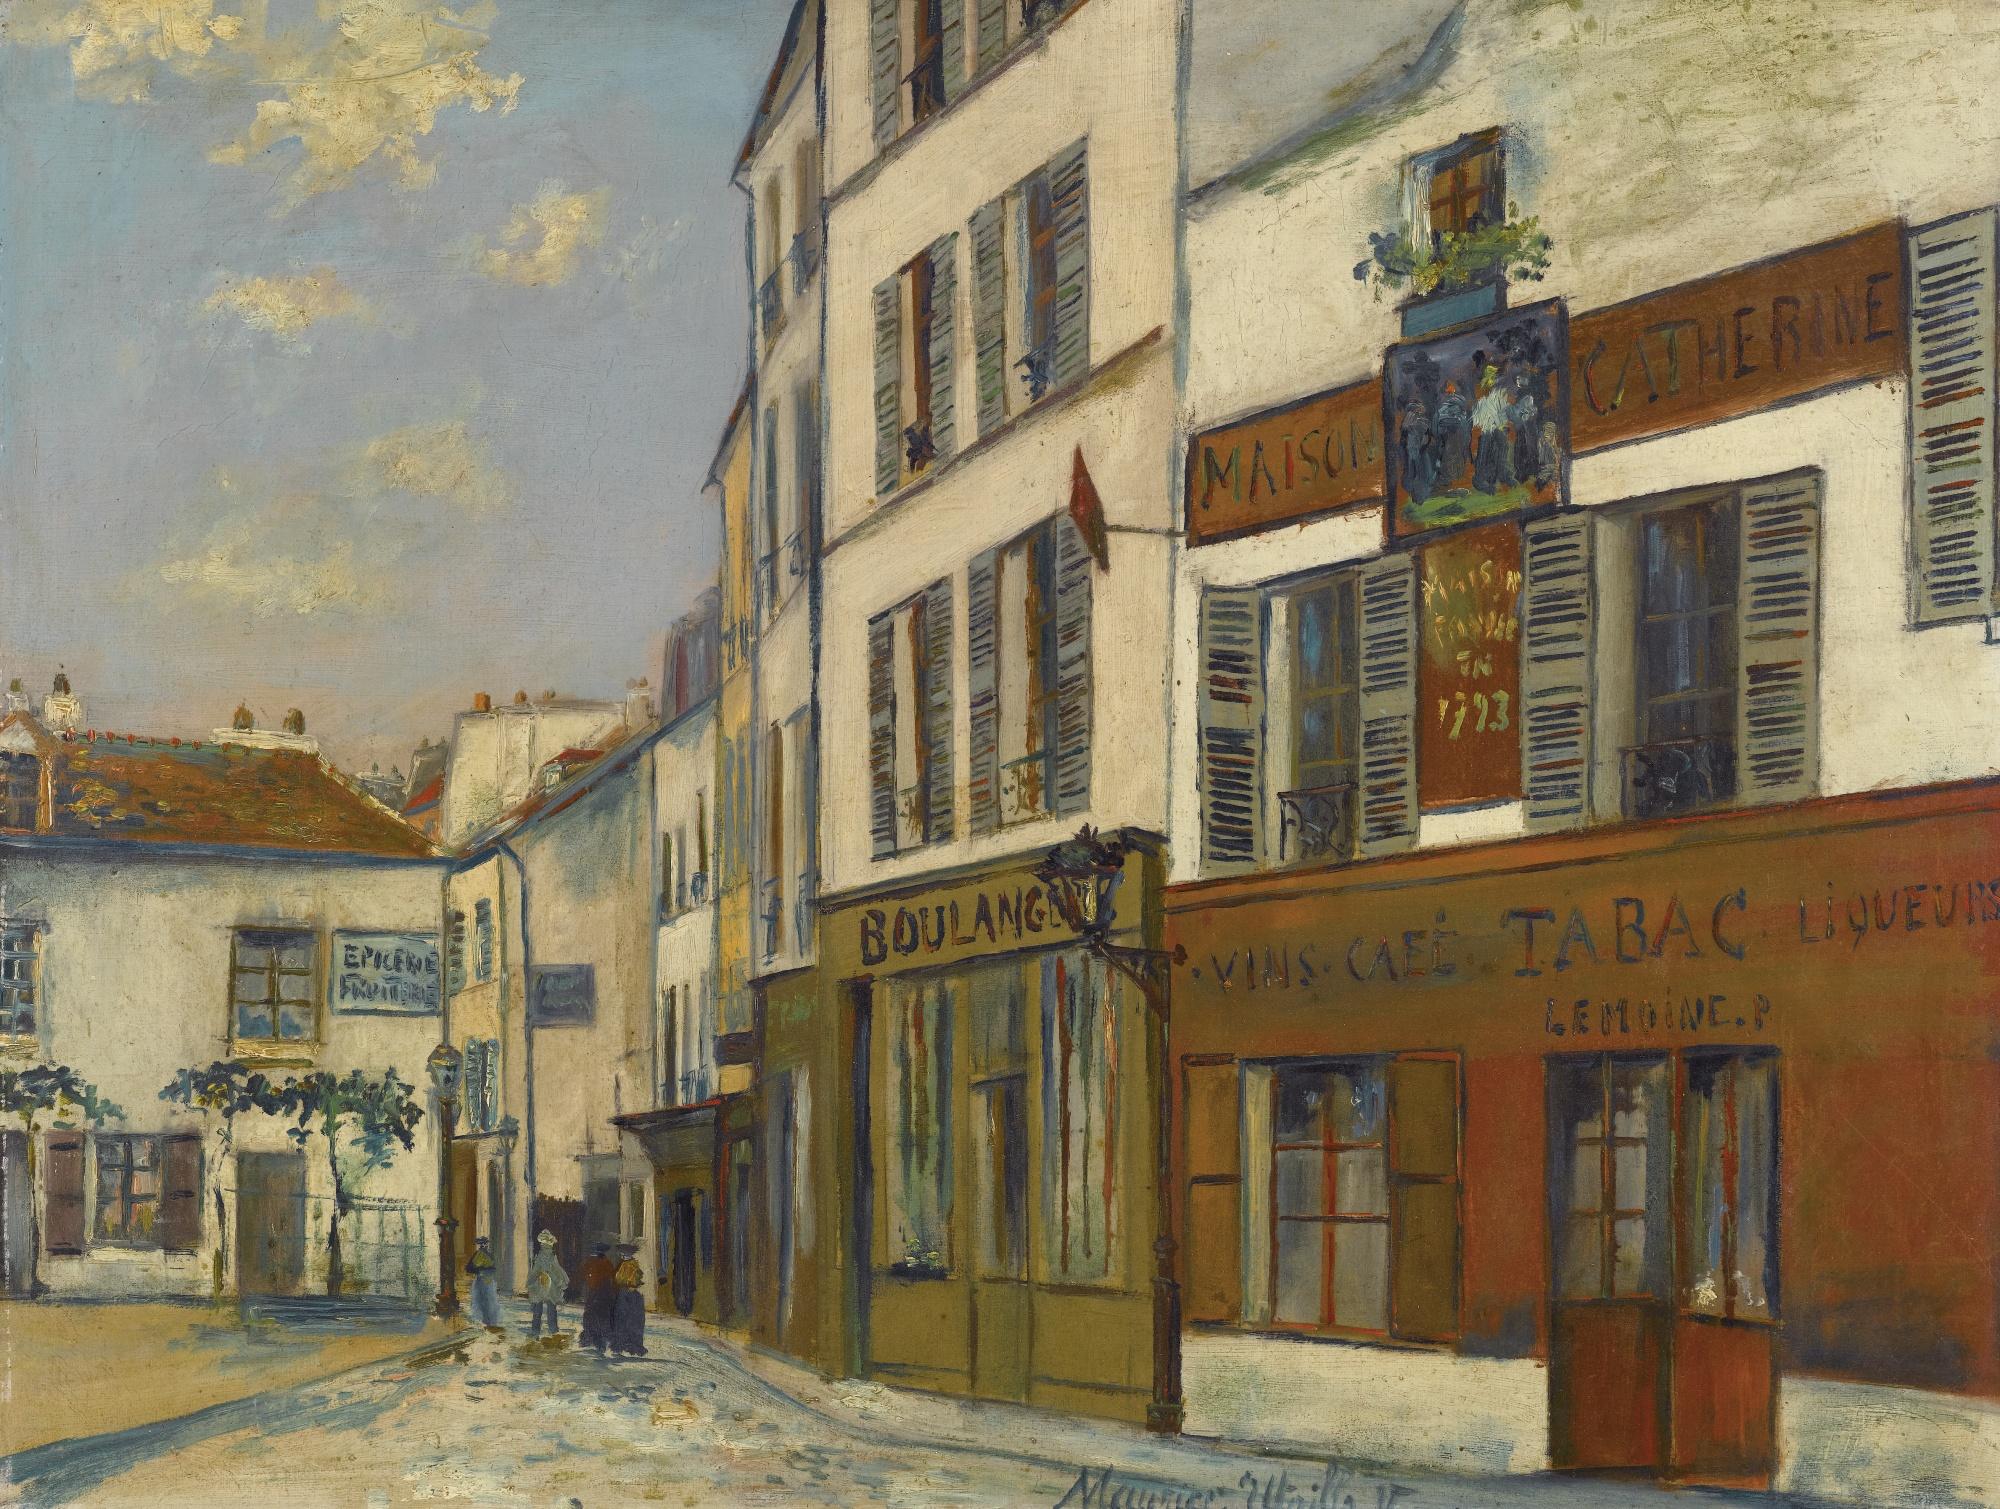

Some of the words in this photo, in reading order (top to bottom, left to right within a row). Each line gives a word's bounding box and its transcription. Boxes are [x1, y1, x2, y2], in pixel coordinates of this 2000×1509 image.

[1201, 414, 1379, 510] MAISON
[1583, 271, 1896, 416] CATHERINE
[1502, 887, 1747, 977] TABAC
